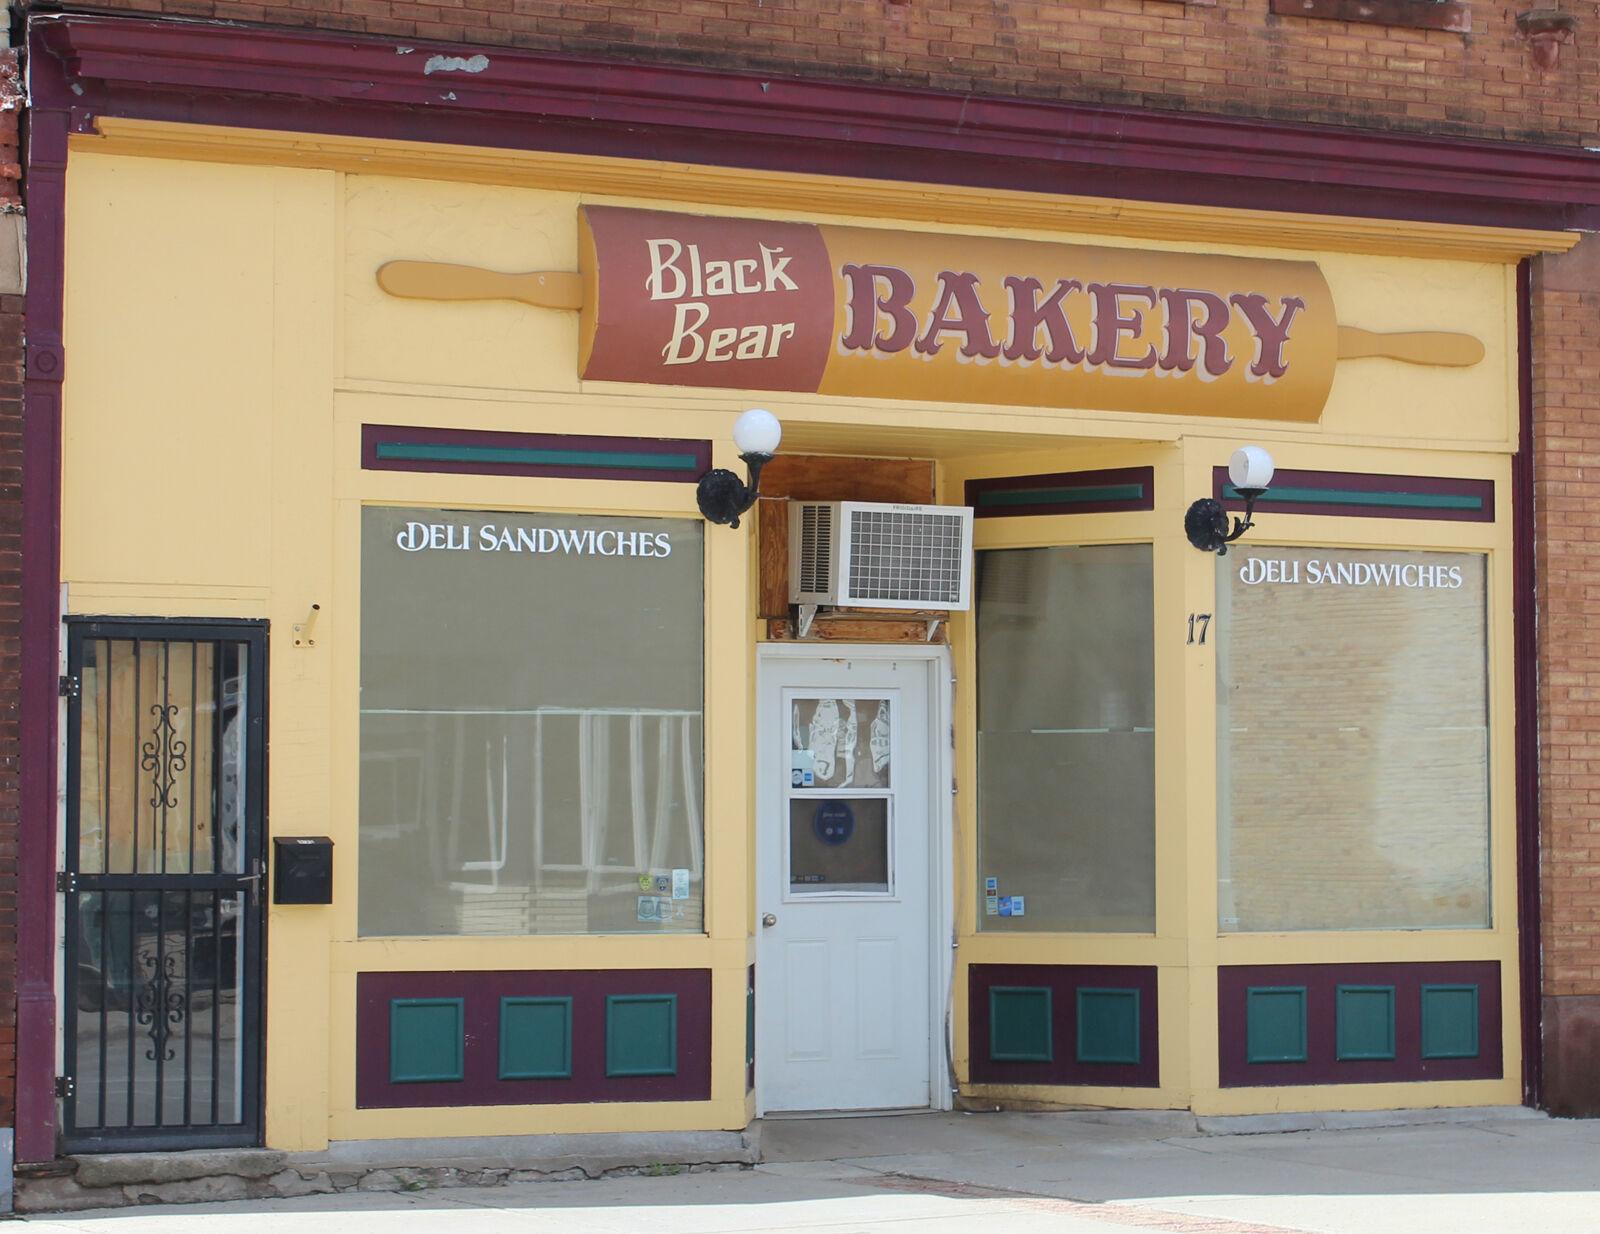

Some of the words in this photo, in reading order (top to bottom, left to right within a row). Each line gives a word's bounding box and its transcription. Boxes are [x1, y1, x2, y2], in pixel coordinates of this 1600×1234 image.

[645, 238, 799, 301] Black
[662, 303, 795, 366] Bear
[838, 263, 1305, 384] BAKERY
[396, 521, 470, 552] DELI
[479, 524, 672, 558] SANDWICHES
[1239, 558, 1300, 585] DELI
[1306, 560, 1463, 589] SANDWICHES
[1186, 612, 1212, 646] 17
